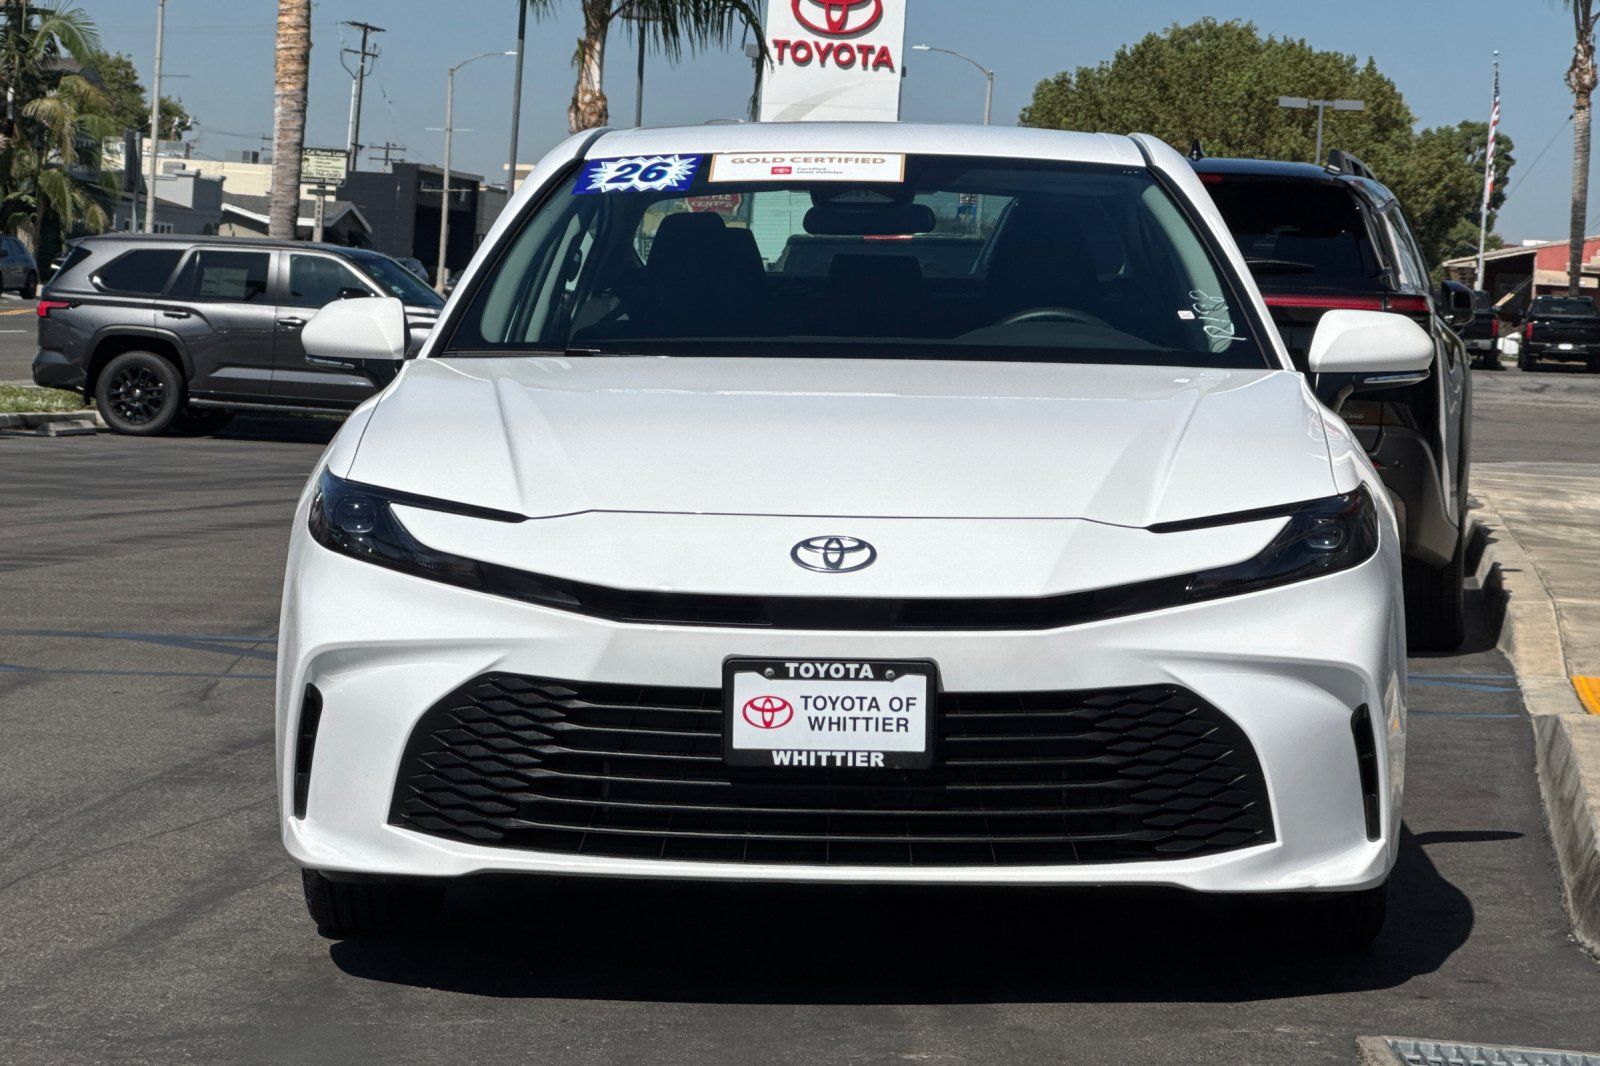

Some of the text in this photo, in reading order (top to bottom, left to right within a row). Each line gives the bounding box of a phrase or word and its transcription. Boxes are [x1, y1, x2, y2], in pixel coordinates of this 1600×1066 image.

[772, 39, 895, 72] TOYOTA
[731, 156, 886, 164] GOLD CERTIFIED
[605, 161, 673, 184] 26
[784, 662, 875, 679] TOYOTA
[800, 695, 917, 713] TOYOTA OF
[808, 716, 909, 733] WHITTIER
[772, 750, 885, 767] WHITTIER
